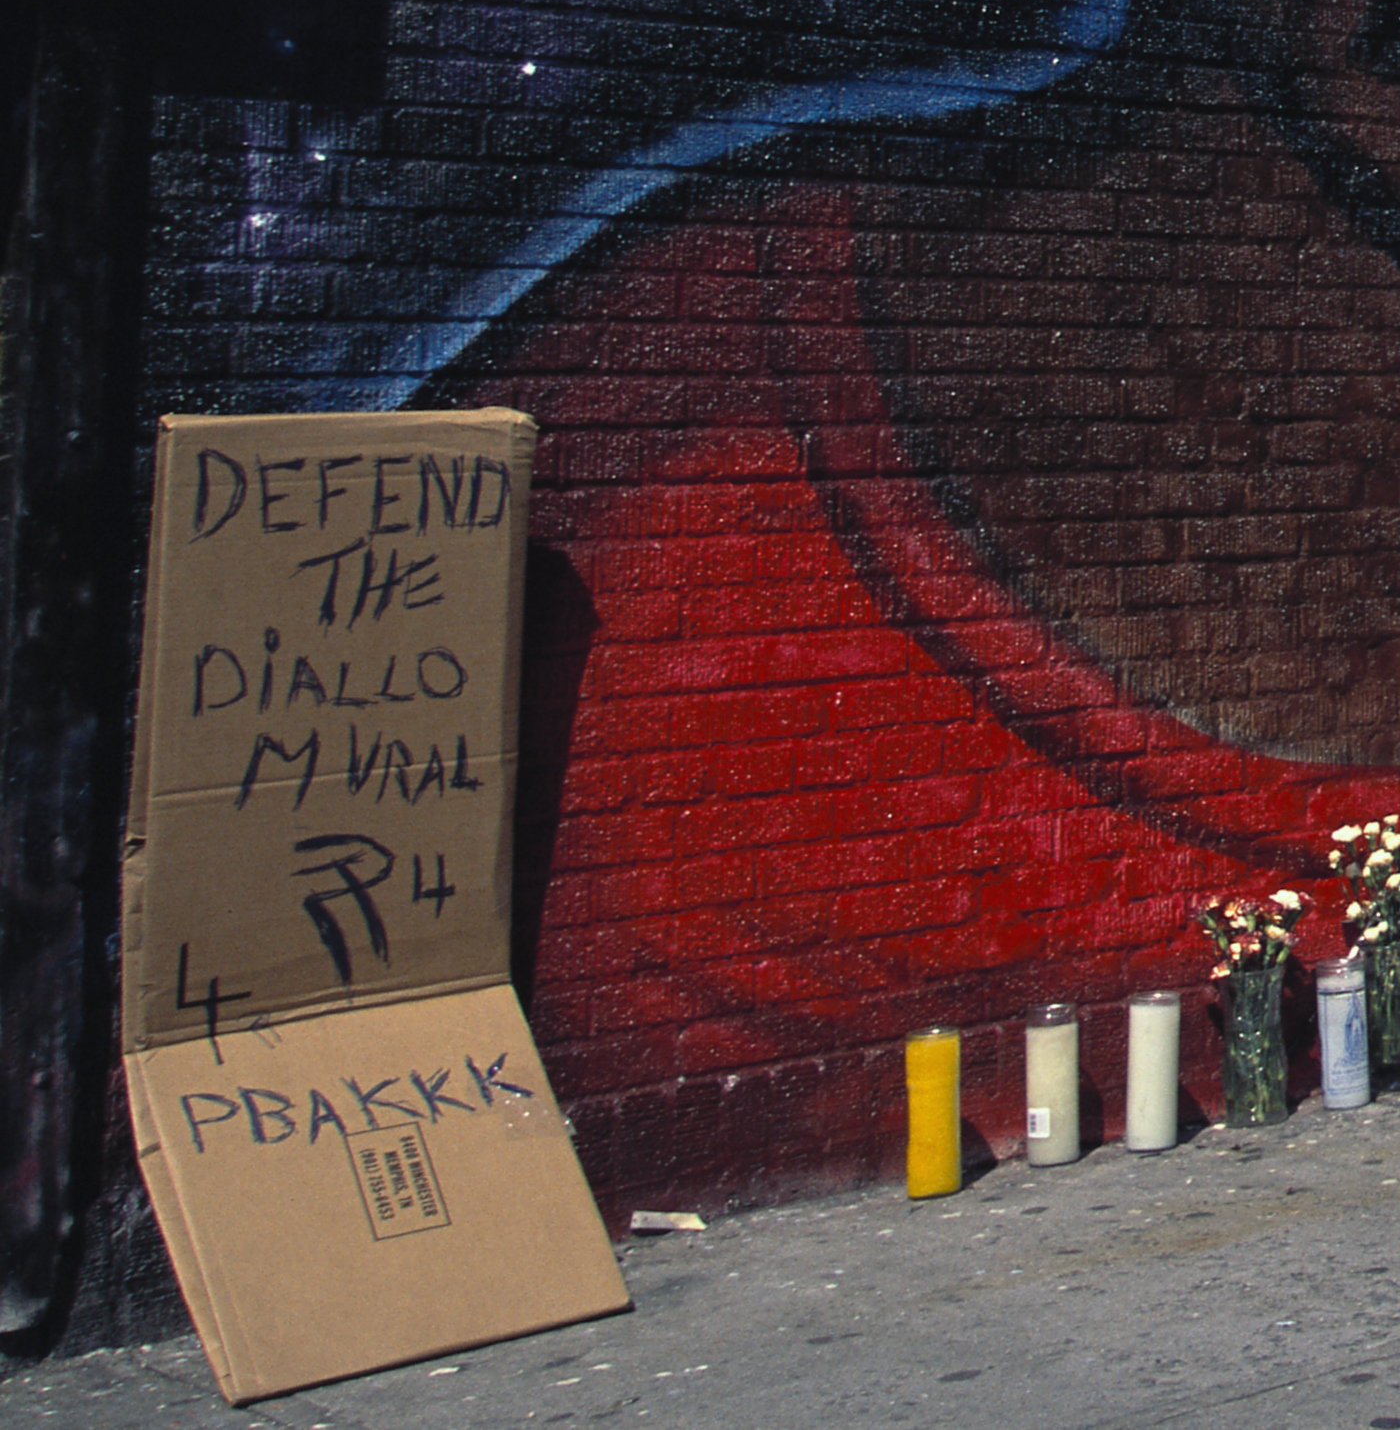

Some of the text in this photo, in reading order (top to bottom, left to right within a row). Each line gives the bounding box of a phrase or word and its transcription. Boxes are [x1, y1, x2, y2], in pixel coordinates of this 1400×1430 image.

[189, 447, 512, 544] DEFEND
[289, 536, 445, 637] THE
[233, 722, 485, 812] MURAL
[383, 1150, 415, 1210] MEMPHIS, TN
[408, 1160, 439, 1218] WINCHESTER
